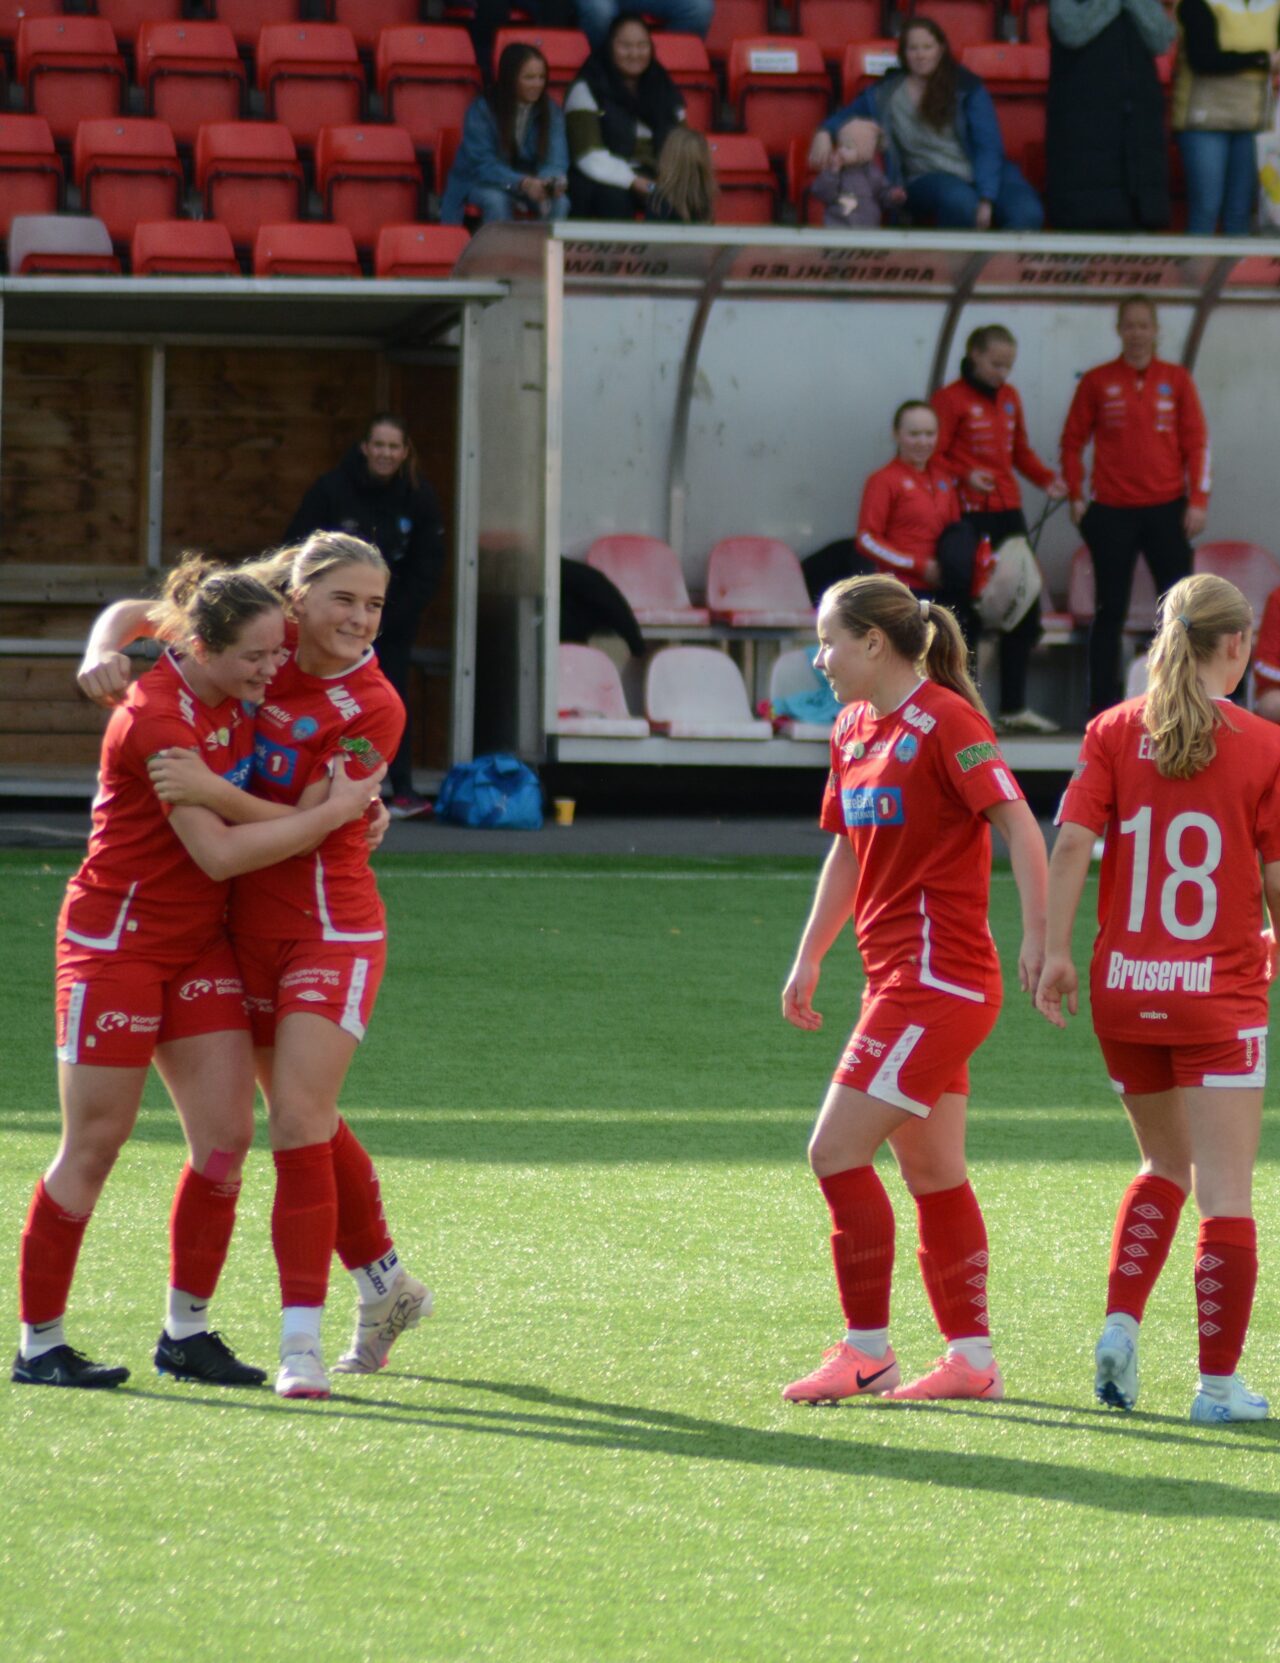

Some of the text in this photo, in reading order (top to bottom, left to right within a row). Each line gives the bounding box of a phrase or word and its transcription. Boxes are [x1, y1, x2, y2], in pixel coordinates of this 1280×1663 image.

[264, 705, 294, 723] Aktiv
[1119, 806, 1223, 941] 18
[1106, 951, 1214, 993] Bruserud
[1139, 1010, 1169, 1020] umbro
